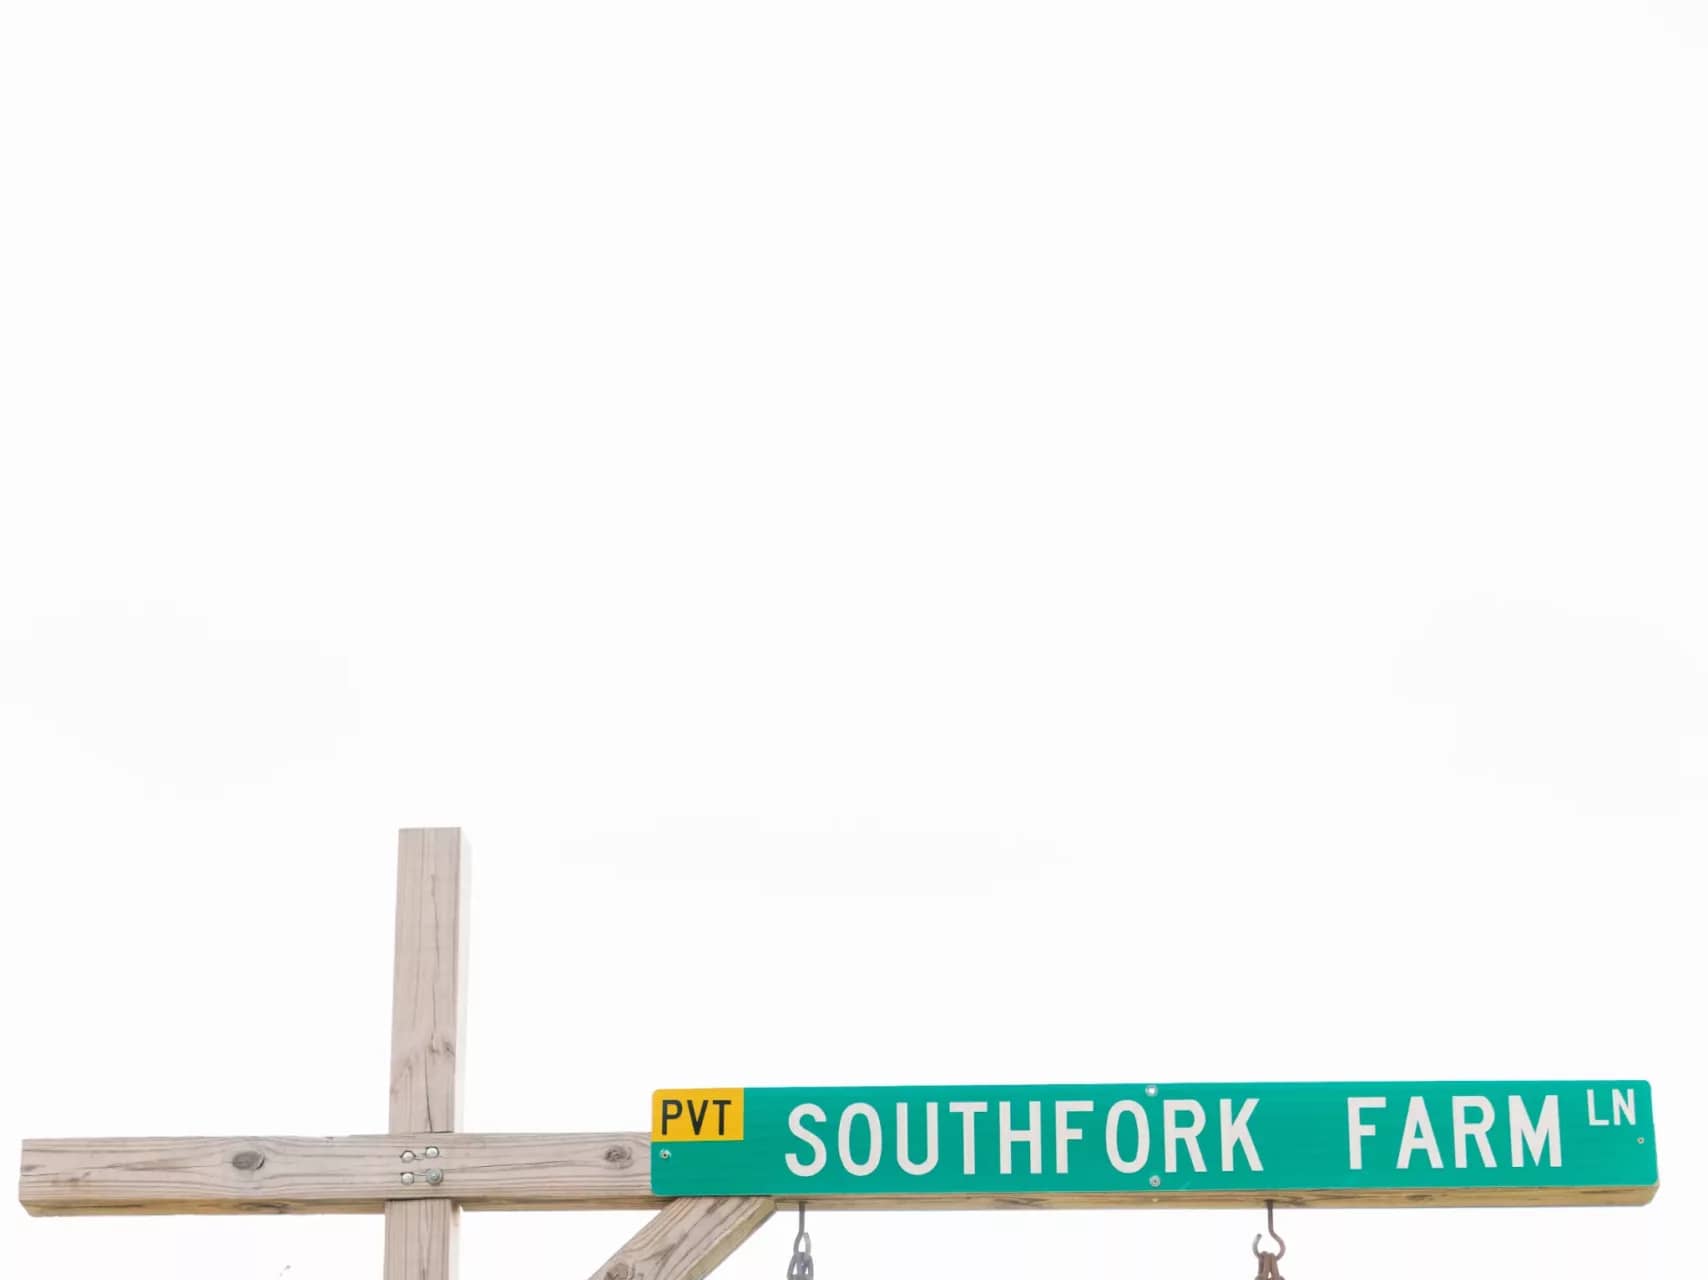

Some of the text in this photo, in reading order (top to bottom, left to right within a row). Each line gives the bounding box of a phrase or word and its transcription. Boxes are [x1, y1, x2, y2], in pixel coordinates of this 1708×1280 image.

[661, 1088, 1636, 1177] PVT SOUTHFORK FARM LN
